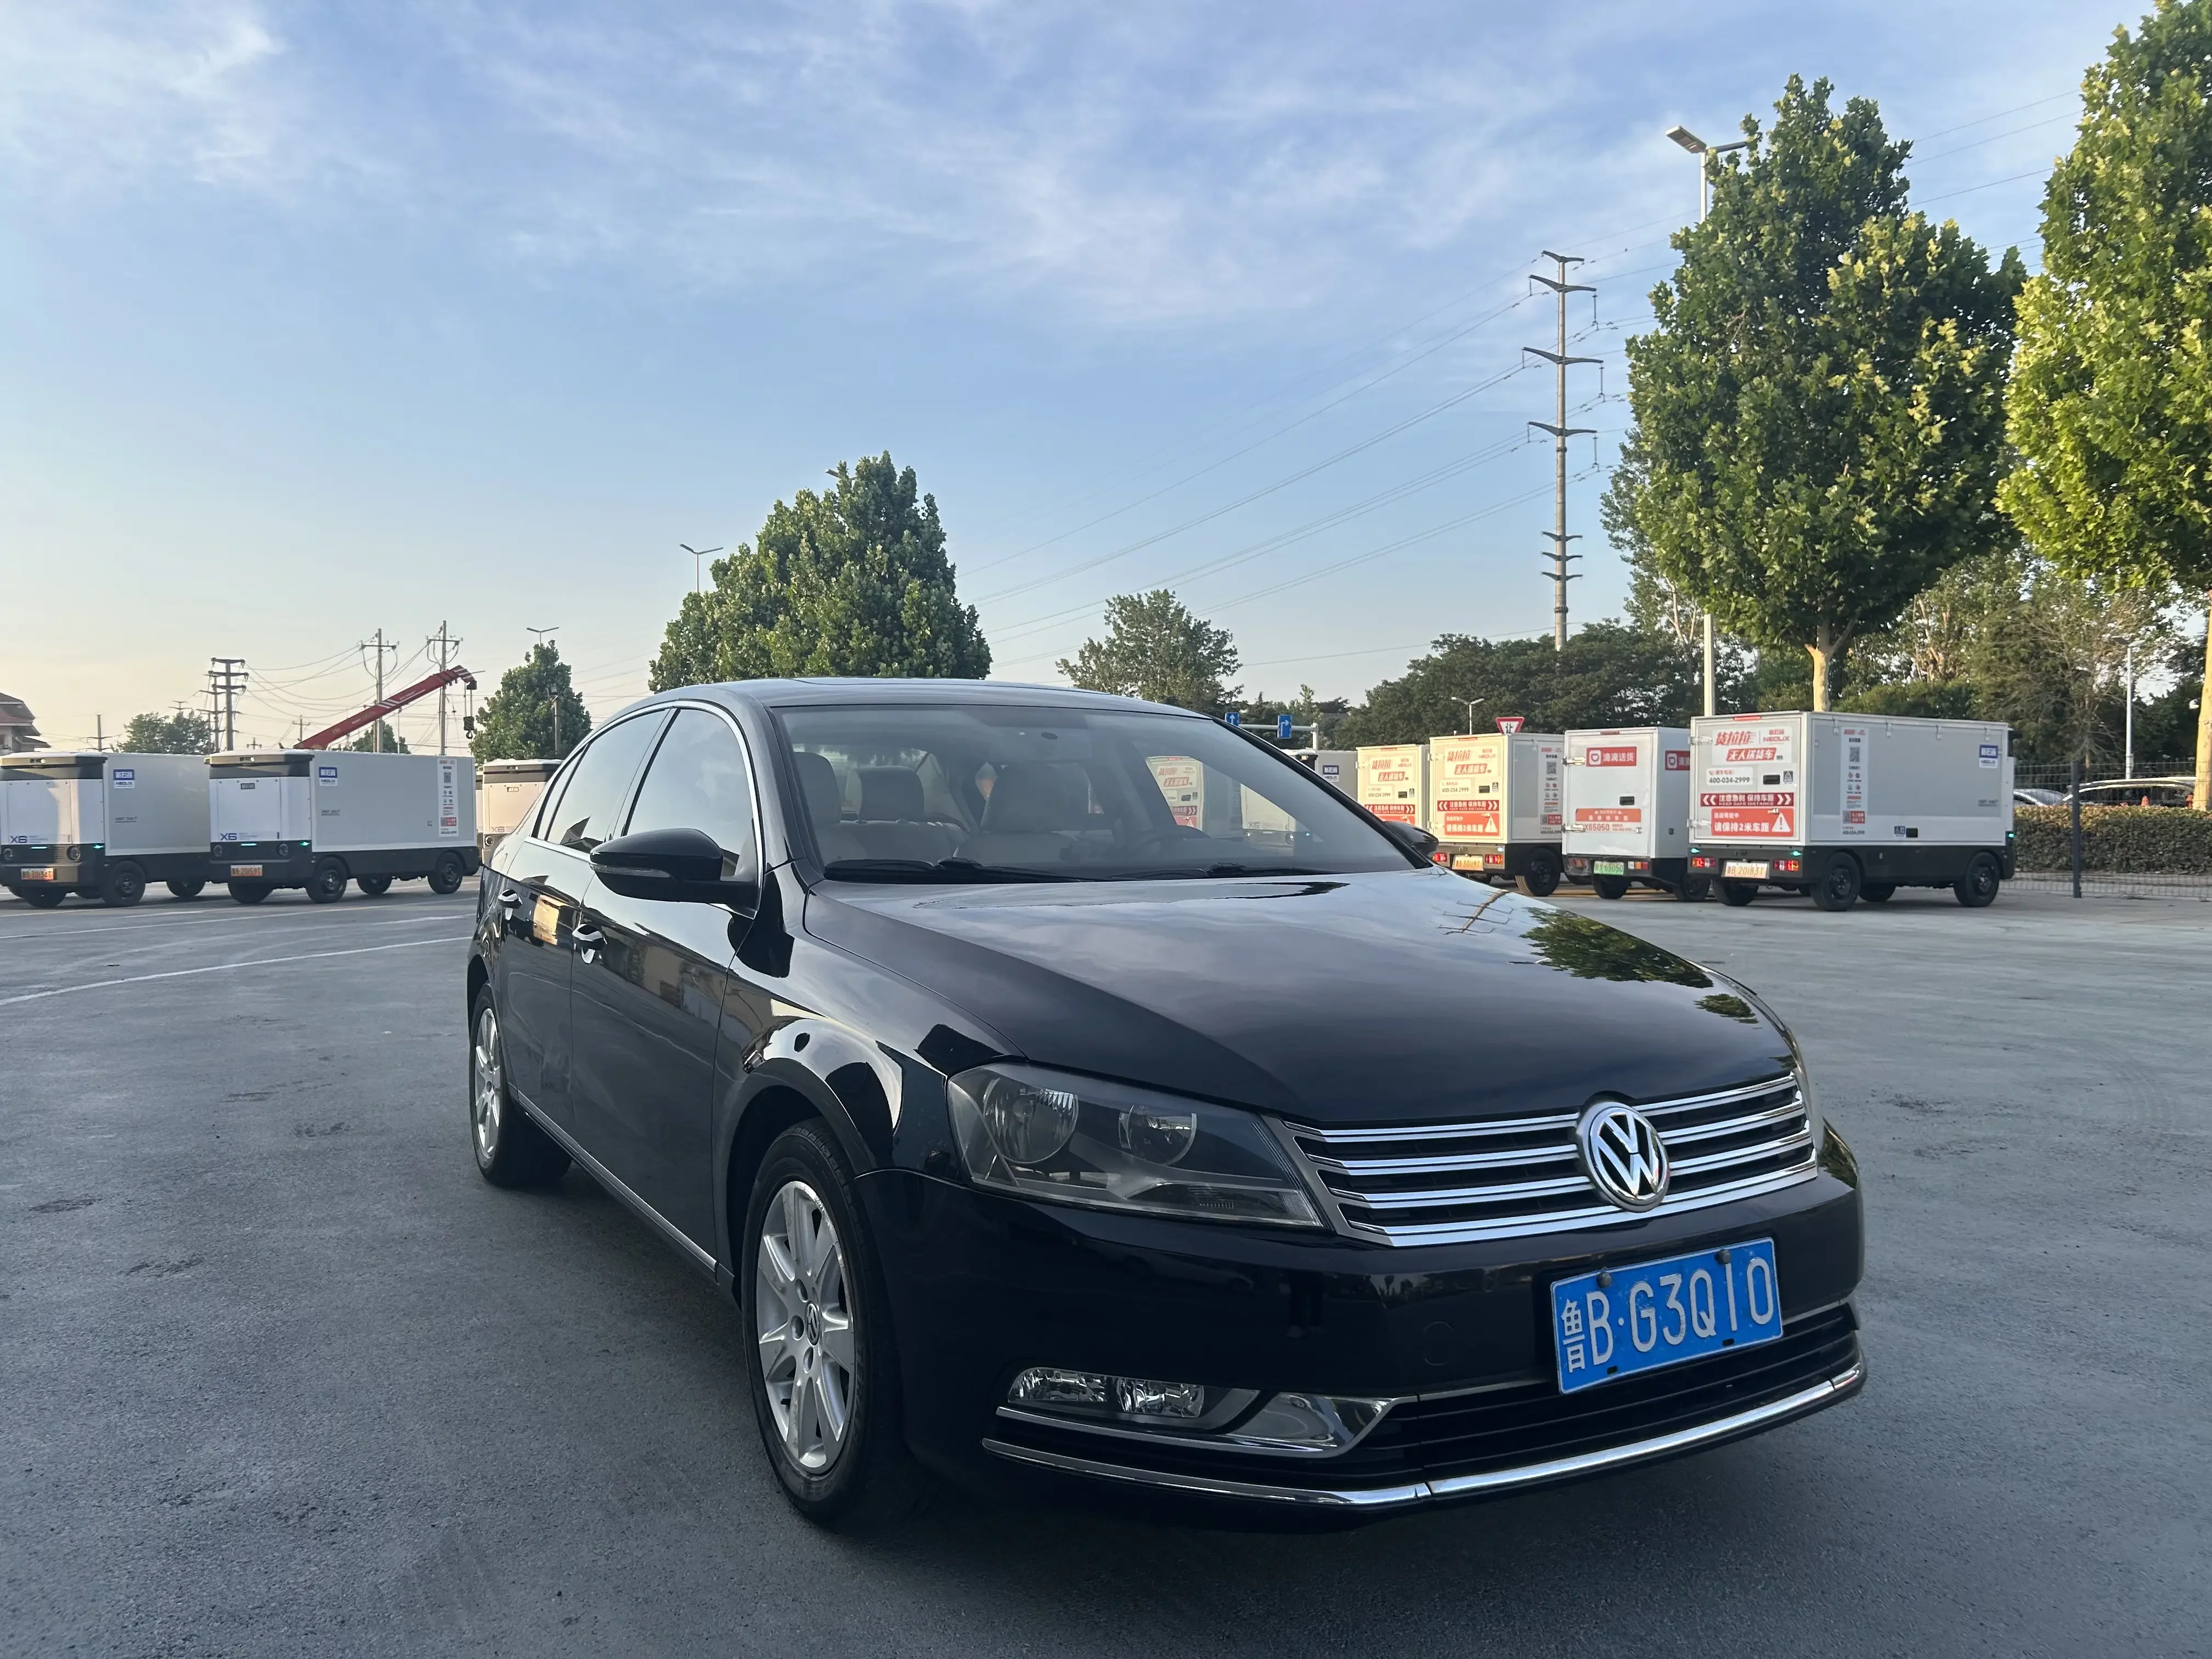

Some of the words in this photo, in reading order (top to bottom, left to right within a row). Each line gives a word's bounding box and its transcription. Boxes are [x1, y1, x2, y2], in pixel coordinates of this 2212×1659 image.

[1505, 723, 1513, 734] 让
[1602, 752, 1634, 762] 滴滴送货
[1587, 1108, 1667, 1204] VW
